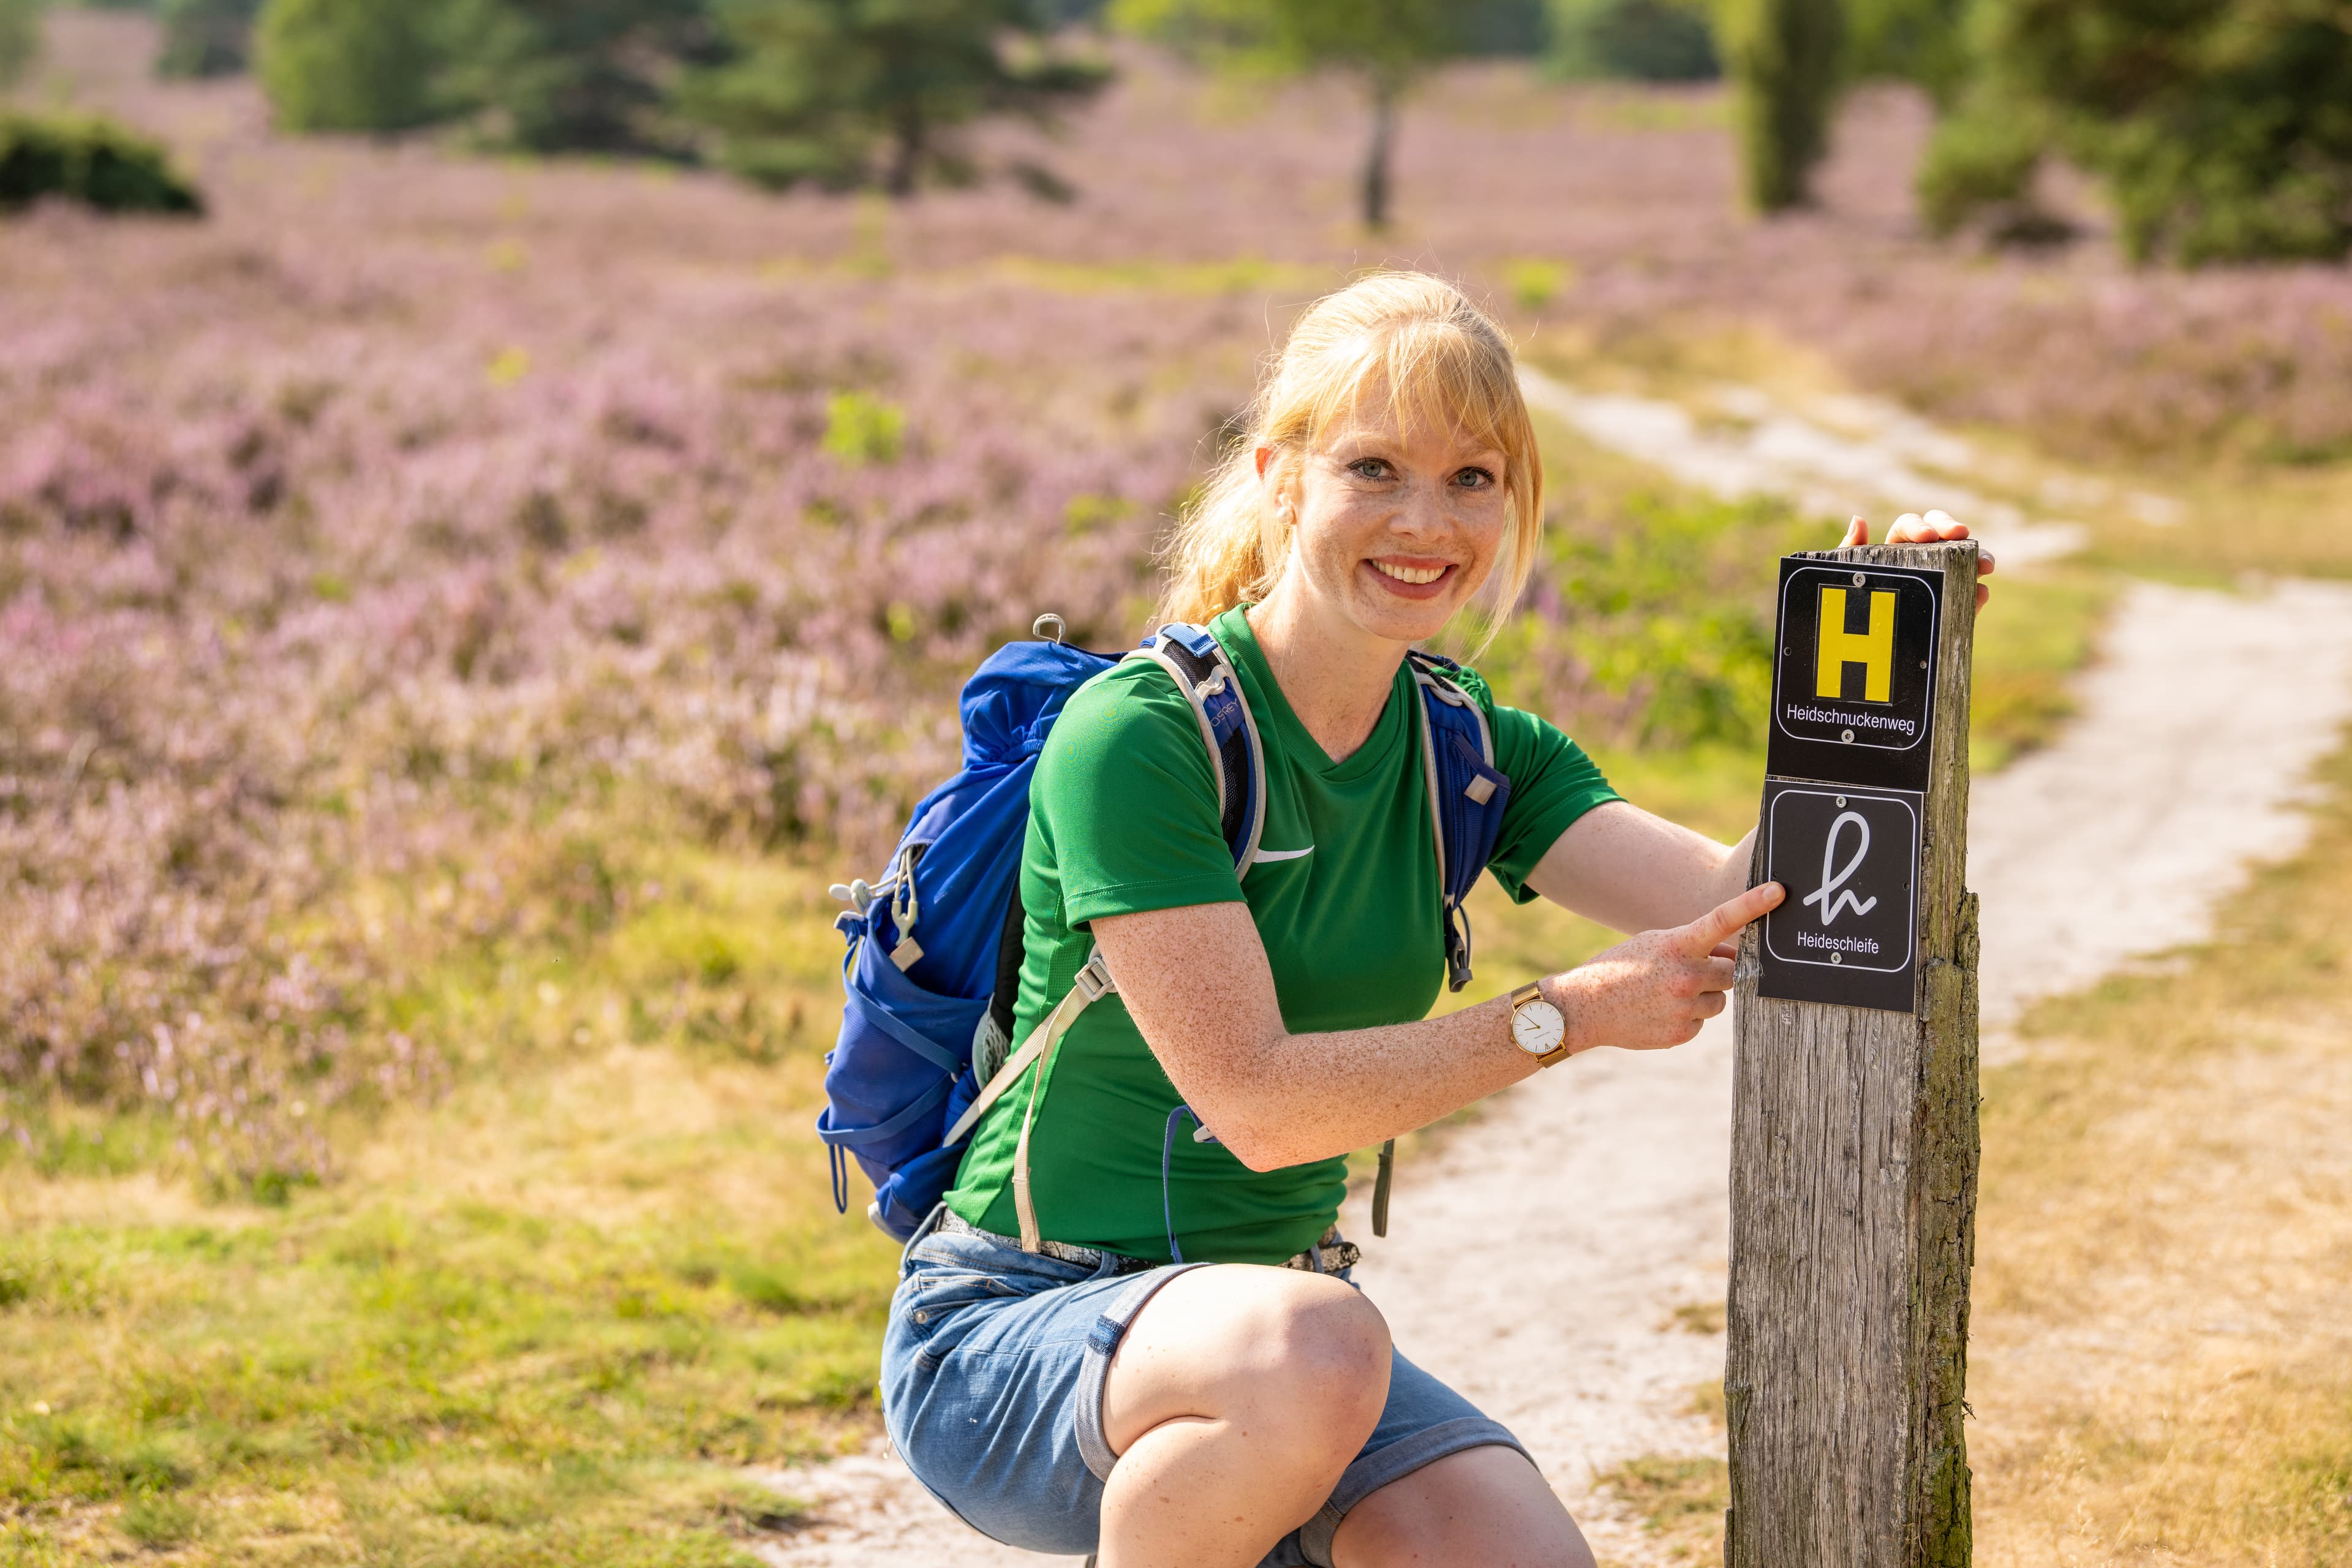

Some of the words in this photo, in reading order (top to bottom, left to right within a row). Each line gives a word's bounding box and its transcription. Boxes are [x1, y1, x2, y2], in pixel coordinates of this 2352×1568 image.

[1817, 588, 1895, 702] H
[1787, 704, 1915, 735] Heidschnuckenweg
[1798, 932, 1879, 954] Heideschleife
